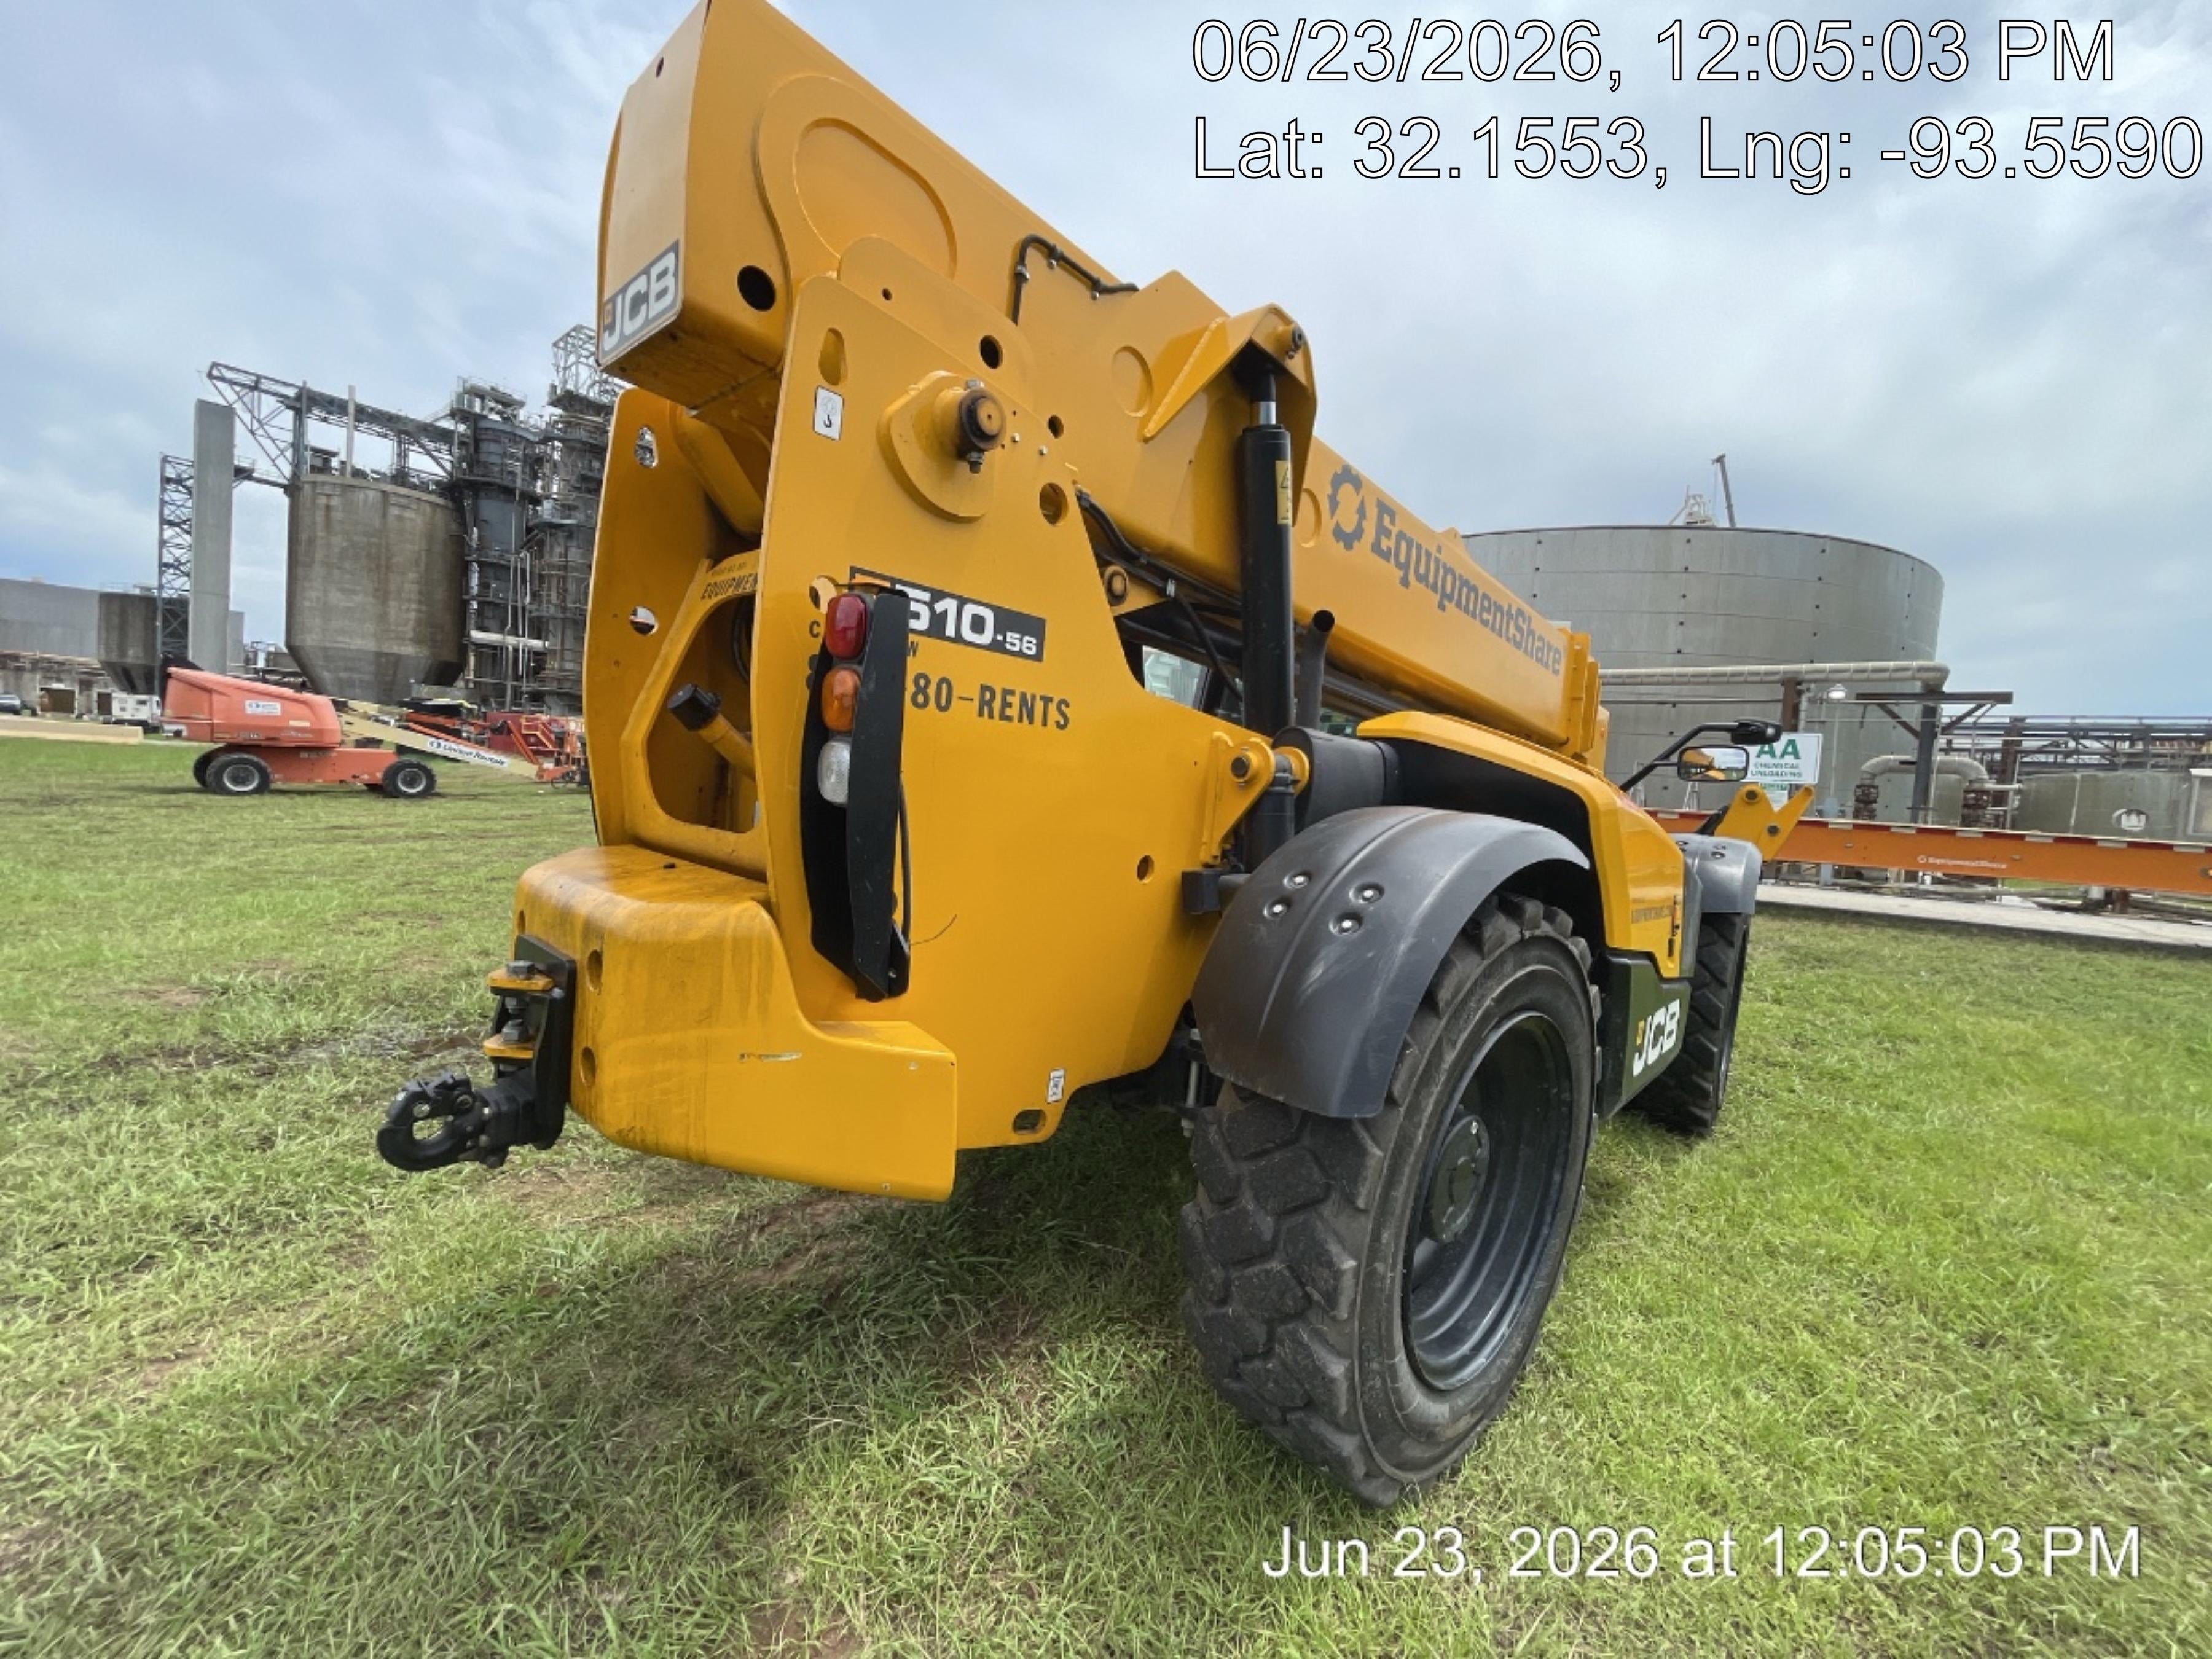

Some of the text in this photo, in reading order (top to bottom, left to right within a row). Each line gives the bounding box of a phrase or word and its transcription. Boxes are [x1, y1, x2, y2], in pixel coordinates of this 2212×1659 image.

[602, 251, 676, 351] JCB
[1370, 497, 1563, 677] EquipmentShare
[1632, 997, 1681, 1078] JCB
